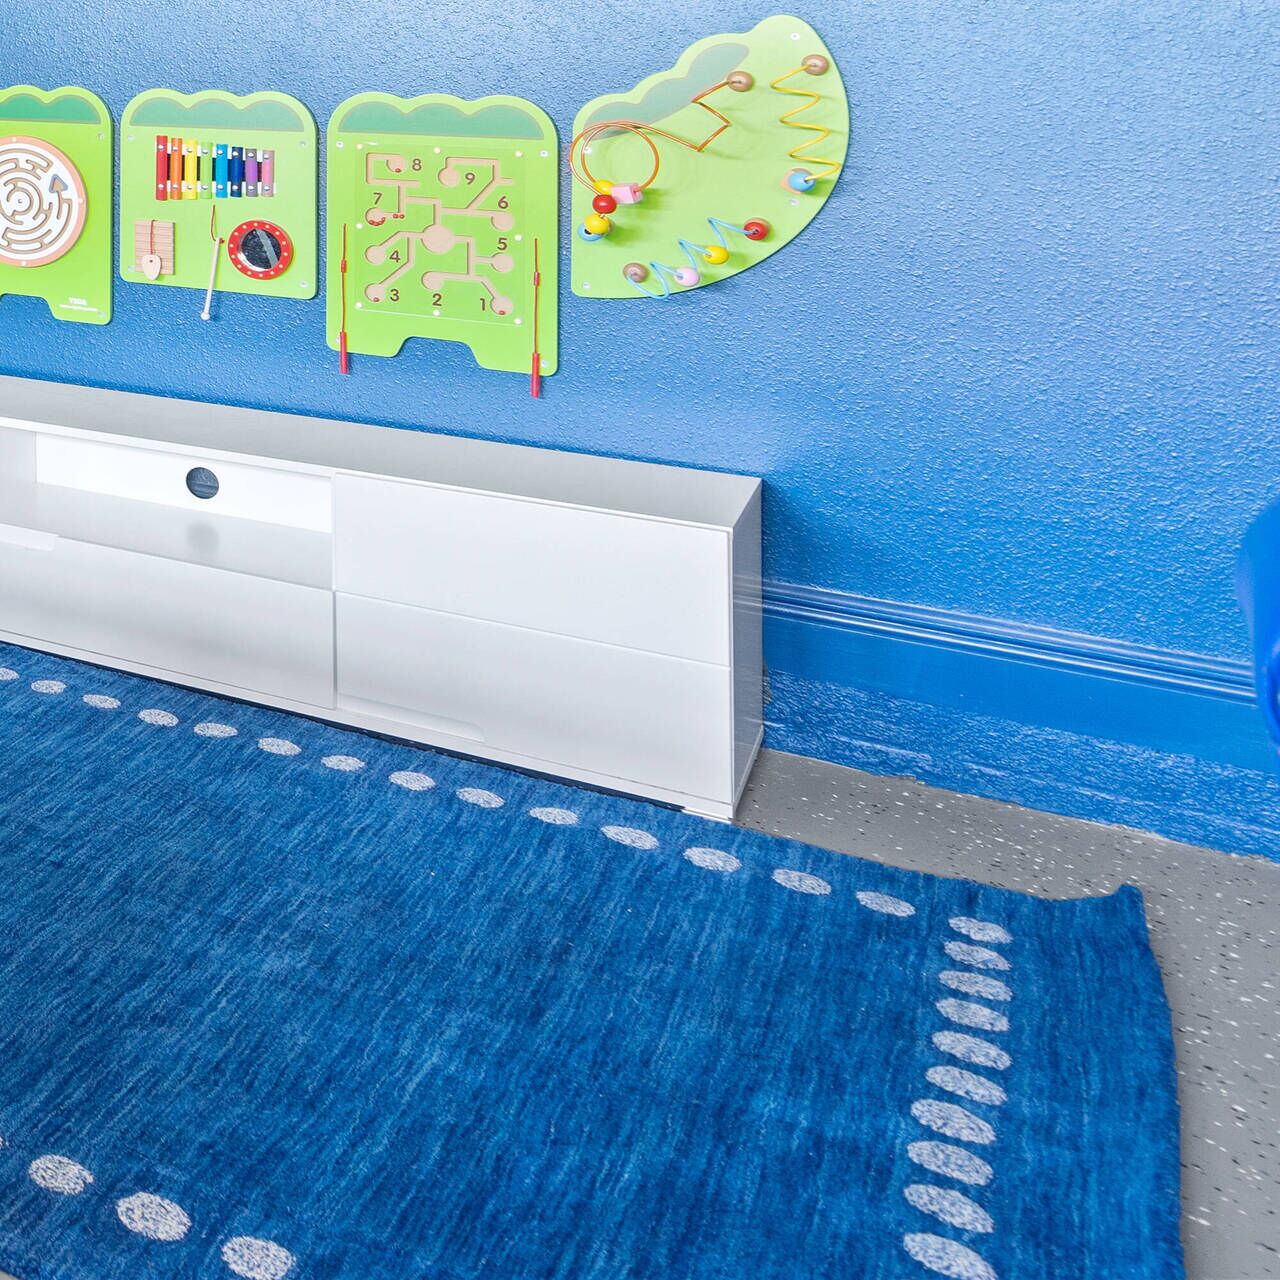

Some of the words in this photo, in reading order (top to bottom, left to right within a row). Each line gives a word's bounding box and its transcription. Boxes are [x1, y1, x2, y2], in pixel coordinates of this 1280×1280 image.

[412, 158, 422, 171] 8
[465, 172, 476, 184] 9
[373, 192, 382, 205] 7
[498, 196, 509, 209] 6
[497, 238, 507, 250] 5
[390, 250, 400, 263] 4
[390, 288, 400, 301] 3
[432, 293, 442, 306] 2
[480, 298, 486, 311] 1
